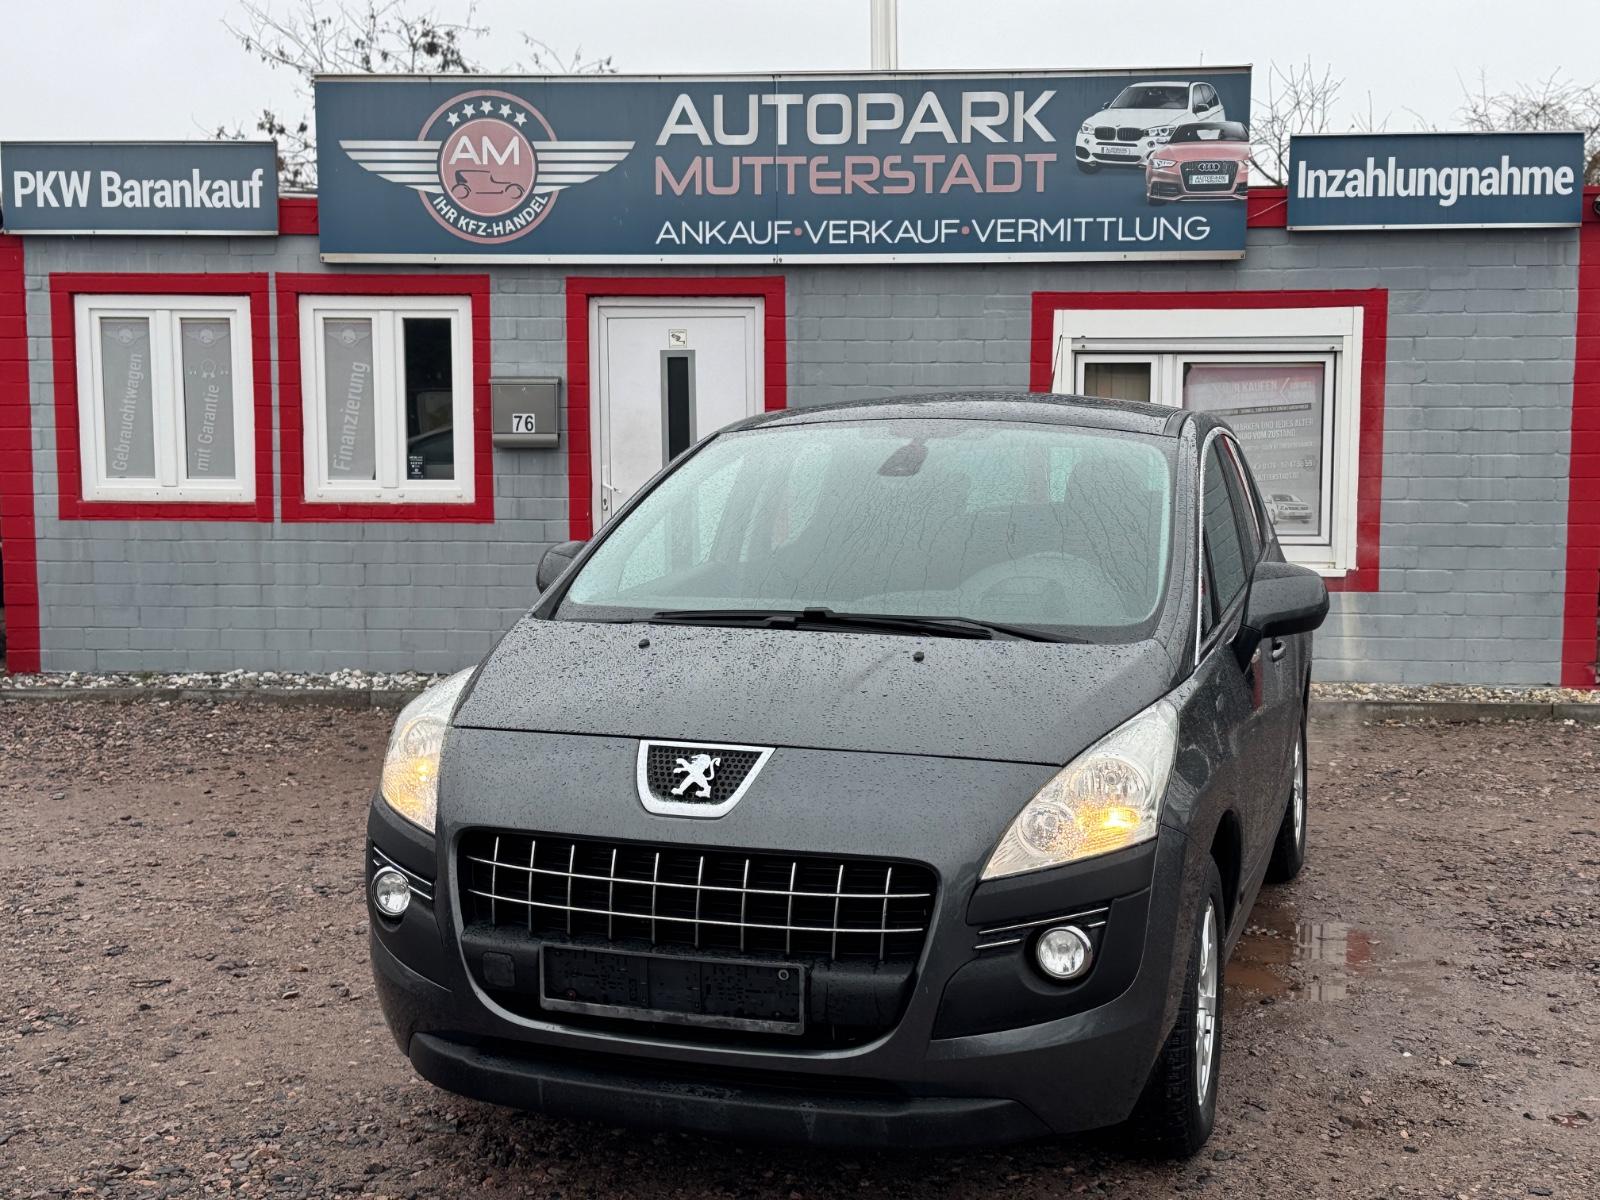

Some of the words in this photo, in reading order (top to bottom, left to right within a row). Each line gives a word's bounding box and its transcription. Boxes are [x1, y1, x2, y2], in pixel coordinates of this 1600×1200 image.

[655, 89, 1057, 146] AUTOPARK
[448, 135, 520, 165] AM
[13, 170, 92, 208] PKW
[100, 168, 264, 209] Barankauf
[654, 153, 1057, 197] MUTTERSTADT
[1297, 155, 1575, 206] Inzahlungnahme
[433, 196, 458, 224] IHR
[457, 195, 548, 236] KFZ-HANDEL
[970, 216, 1211, 242] VERMITTLUNG
[112, 352, 144, 472] Gebrauchtwagen
[198, 384, 219, 445] Garantie
[333, 361, 370, 472] Finanzierung
[513, 415, 534, 432] 76
[197, 446, 209, 471] mit
